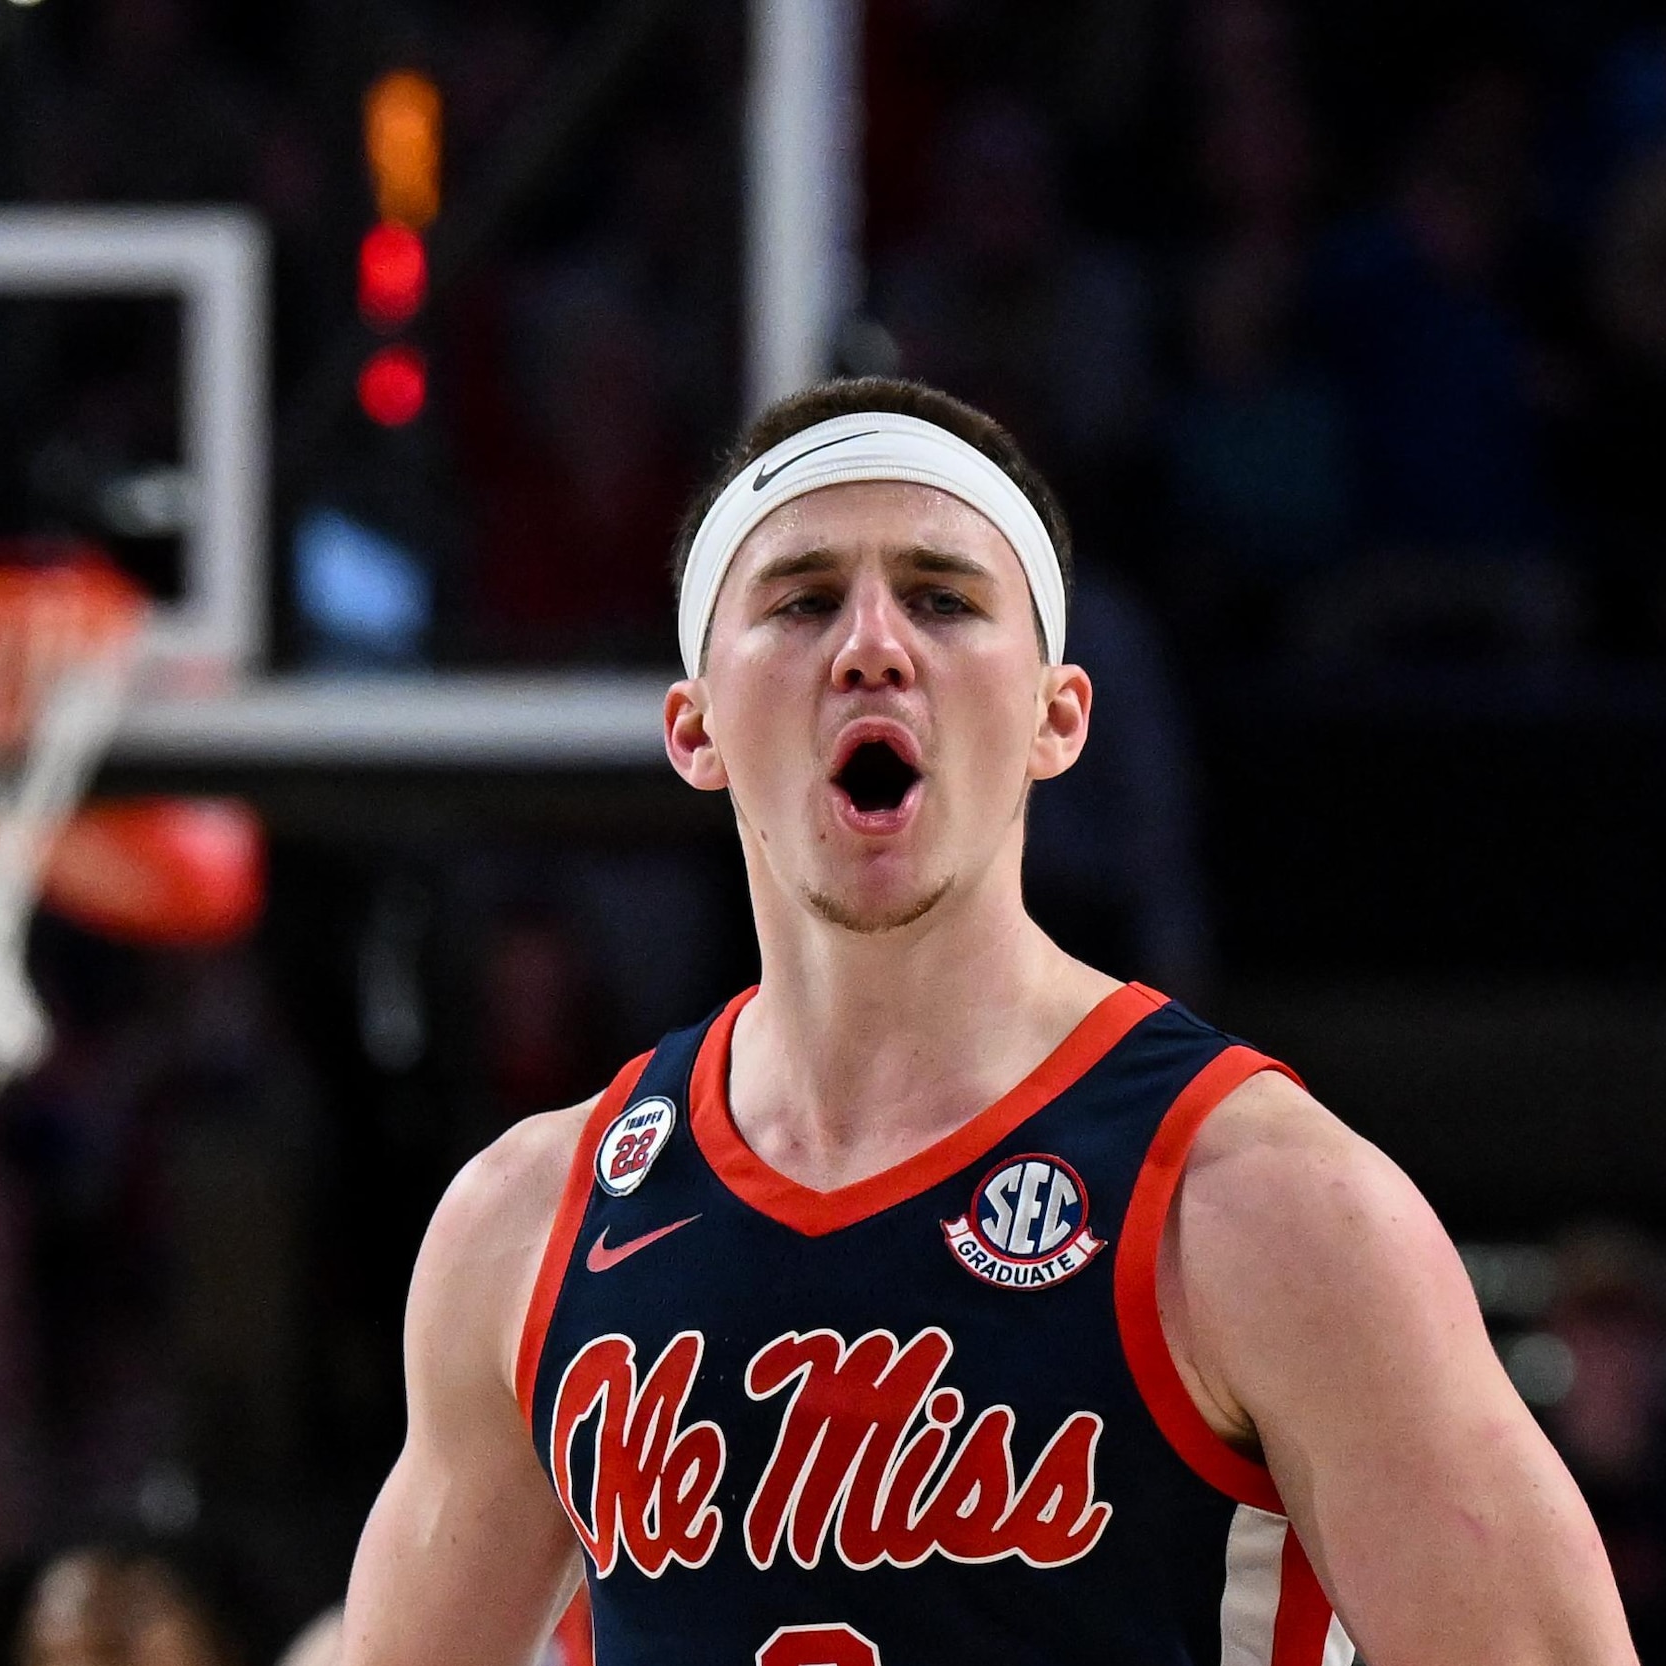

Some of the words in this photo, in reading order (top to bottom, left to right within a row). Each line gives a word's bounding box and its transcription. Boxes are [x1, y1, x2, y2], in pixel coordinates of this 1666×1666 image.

[609, 1127, 658, 1180] 22
[981, 1161, 1079, 1255] SEC
[957, 1240, 1076, 1286] GRADUATE
[551, 1330, 727, 1580] Ole
[744, 1327, 1113, 1571] Miss
